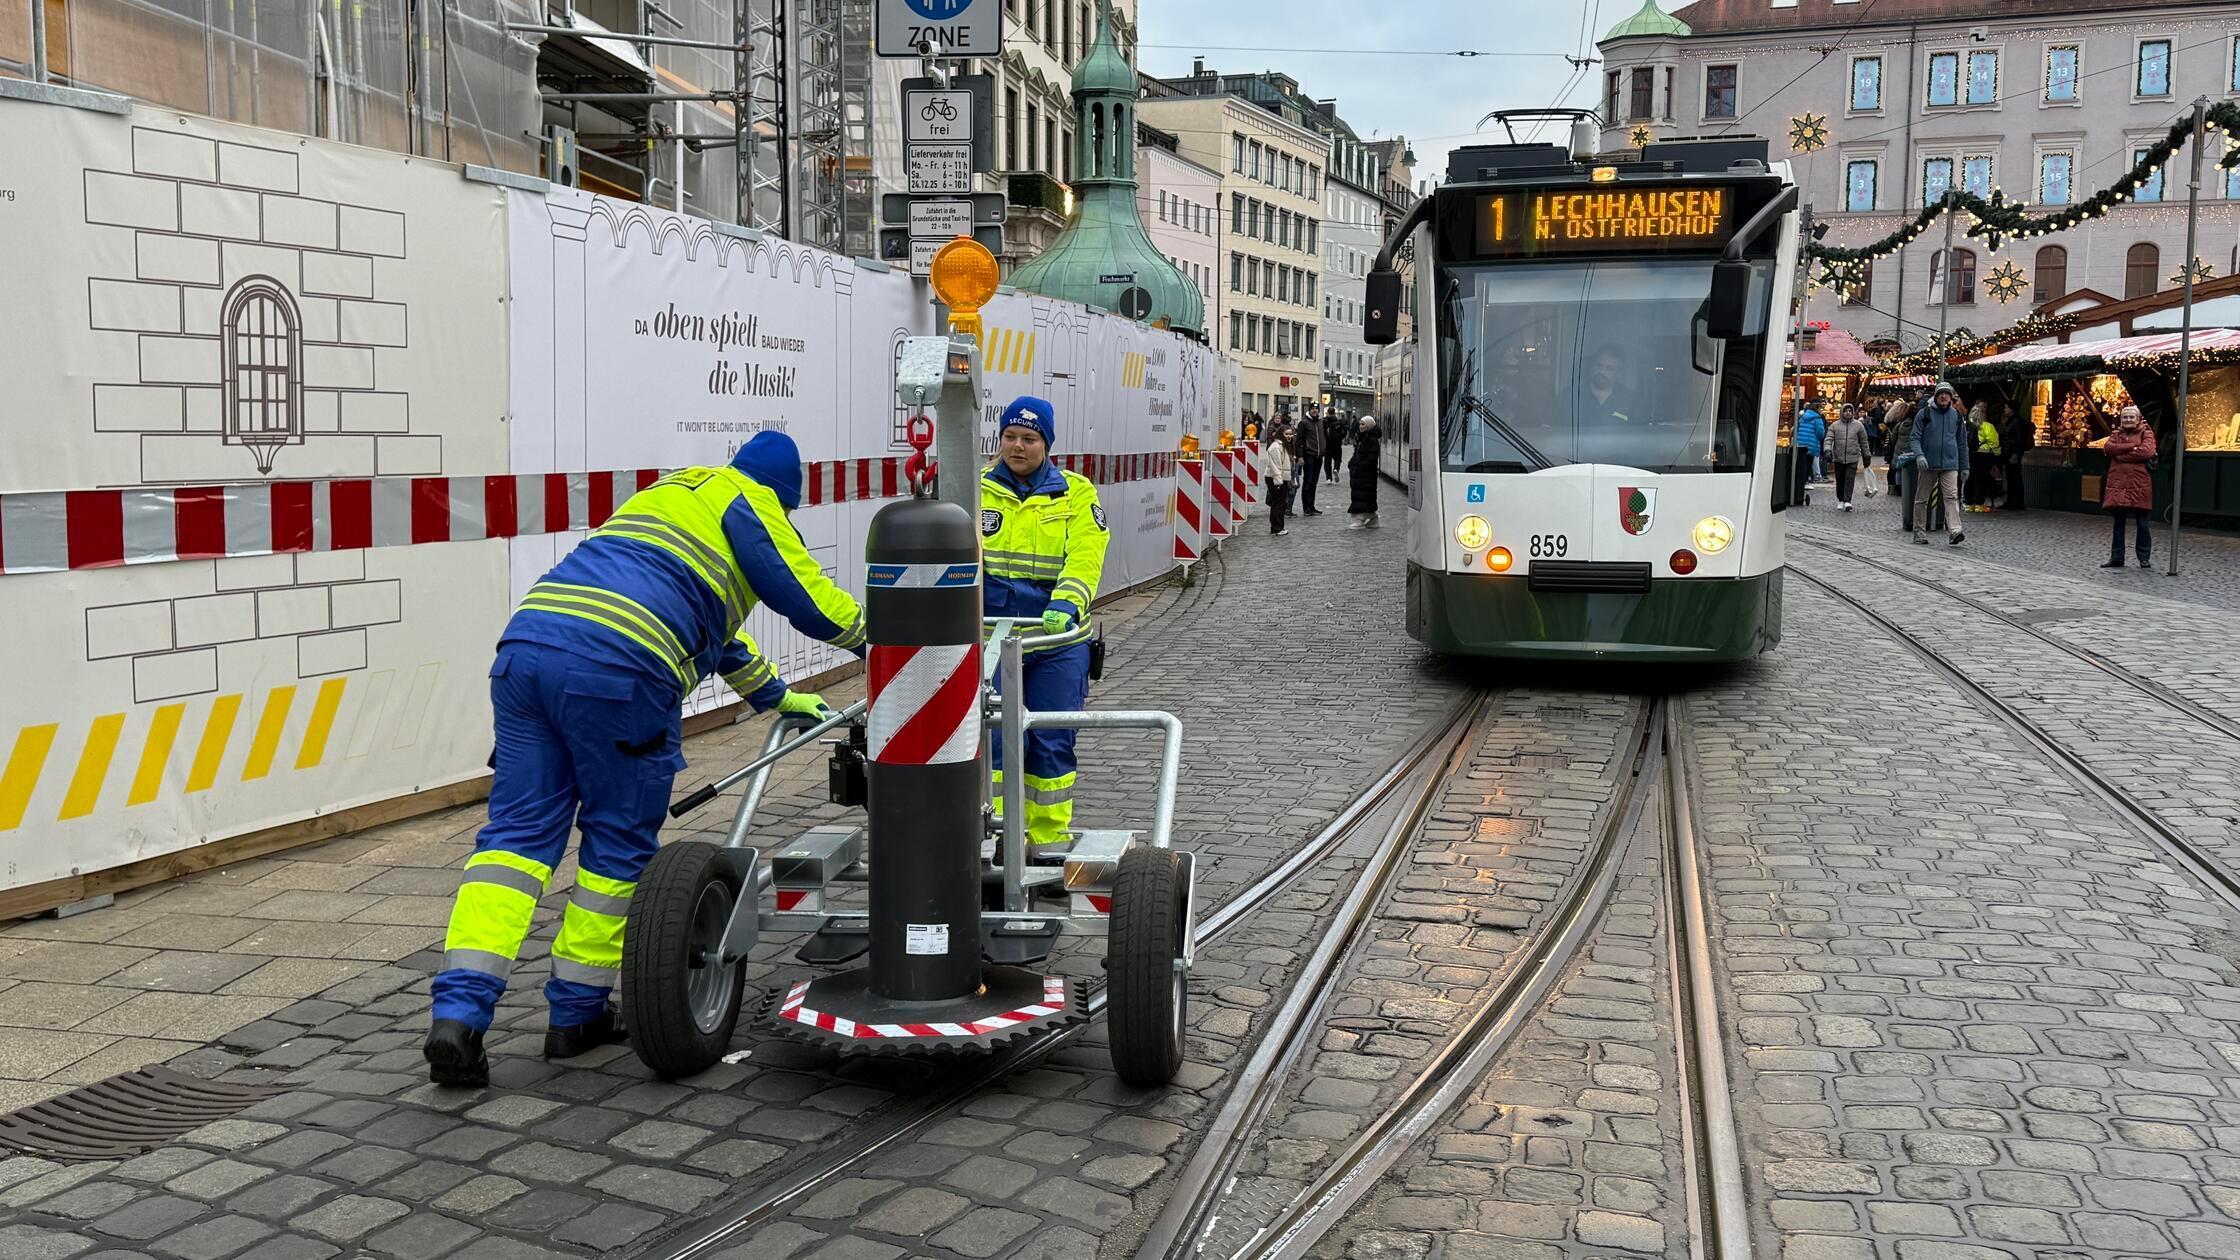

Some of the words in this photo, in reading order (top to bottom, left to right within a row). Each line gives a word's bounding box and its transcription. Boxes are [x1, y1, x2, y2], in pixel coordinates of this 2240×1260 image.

[908, 26, 970, 47] ZONE
[2150, 62, 2158, 71] 5
[1975, 72, 1988, 81] 14
[2056, 67, 2068, 77] 13
[1859, 78, 1872, 88] 19
[1940, 74, 1947, 83] 2
[930, 123, 950, 135] frei
[911, 149, 954, 159] Lieferverkehr
[955, 149, 967, 159] frei
[911, 161, 924, 170] Mo.
[930, 161, 940, 170] Fr.
[942, 161, 947, 170] 6
[954, 161, 962, 170] 11
[963, 161, 968, 170] h
[911, 170, 922, 179] Sa.
[942, 170, 947, 179] 6
[954, 170, 962, 179] 10
[963, 170, 968, 179] h
[2049, 172, 2062, 183] 15
[911, 180, 938, 189] 24.12.25
[942, 180, 947, 189] 6
[954, 180, 962, 189] 10
[963, 180, 968, 189] h
[1858, 180, 1865, 189] 3
[1931, 177, 1944, 187] 22
[1973, 176, 1980, 185] 9
[926, 207, 943, 215] Zufahrt
[1491, 197, 1504, 241] 1
[1536, 191, 1721, 220] LECHHAUSEN
[1535, 221, 1556, 240] N.
[1566, 215, 1722, 239] OSTFRIEDHOF
[635, 319, 649, 336] DA
[654, 302, 705, 341] oben
[709, 311, 758, 352] spielt
[761, 335, 779, 350] BALD
[780, 337, 805, 353] WIEDER
[708, 360, 738, 395] die
[742, 363, 796, 398] Musik!
[676, 421, 683, 433] IT
[684, 421, 707, 433] WON'T
[708, 421, 716, 433] BE
[717, 421, 734, 433] LONG
[734, 421, 750, 433] UNTIL
[751, 421, 760, 433] THE
[762, 415, 788, 433] music
[1009, 417, 1041, 432] SECURITY
[1529, 534, 1568, 558] 859
